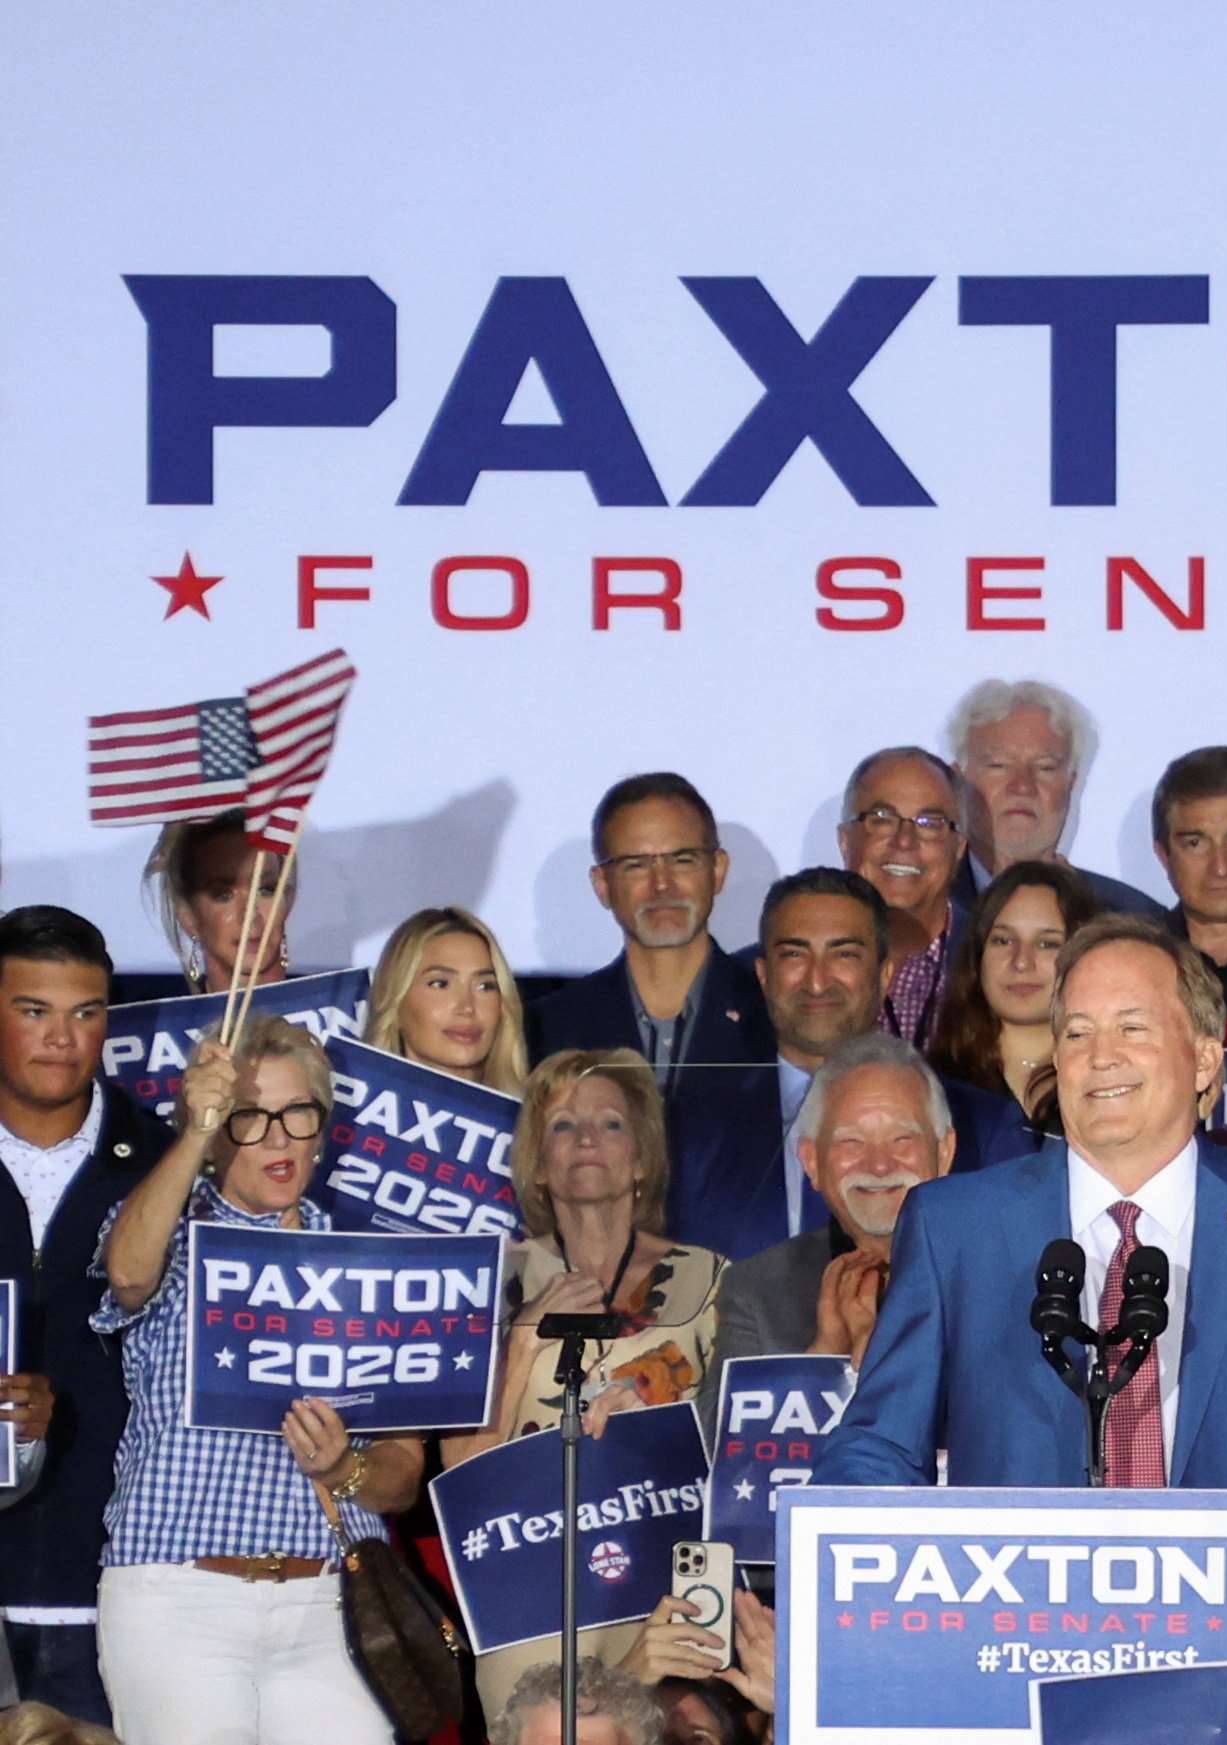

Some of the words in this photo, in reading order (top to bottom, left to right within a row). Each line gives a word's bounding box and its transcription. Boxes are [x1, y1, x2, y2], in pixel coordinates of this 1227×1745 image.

[298, 556, 683, 631] FOR
[330, 1071, 514, 1178] PAXTO
[331, 1124, 387, 1156] OR
[406, 1152, 514, 1203] SENA
[202, 1258, 491, 1313] PAXTON
[205, 1309, 288, 1333] FOR
[312, 1313, 487, 1338] SENATE
[248, 1339, 442, 1388] 2026
[728, 1390, 846, 1435] PAX
[726, 1440, 810, 1461] FOR
[829, 1543, 1226, 1605] PAXTON
[870, 1610, 966, 1634] FOR
[993, 1611, 1189, 1635] SENATE
[976, 1640, 1200, 1674] #TexasFirst
